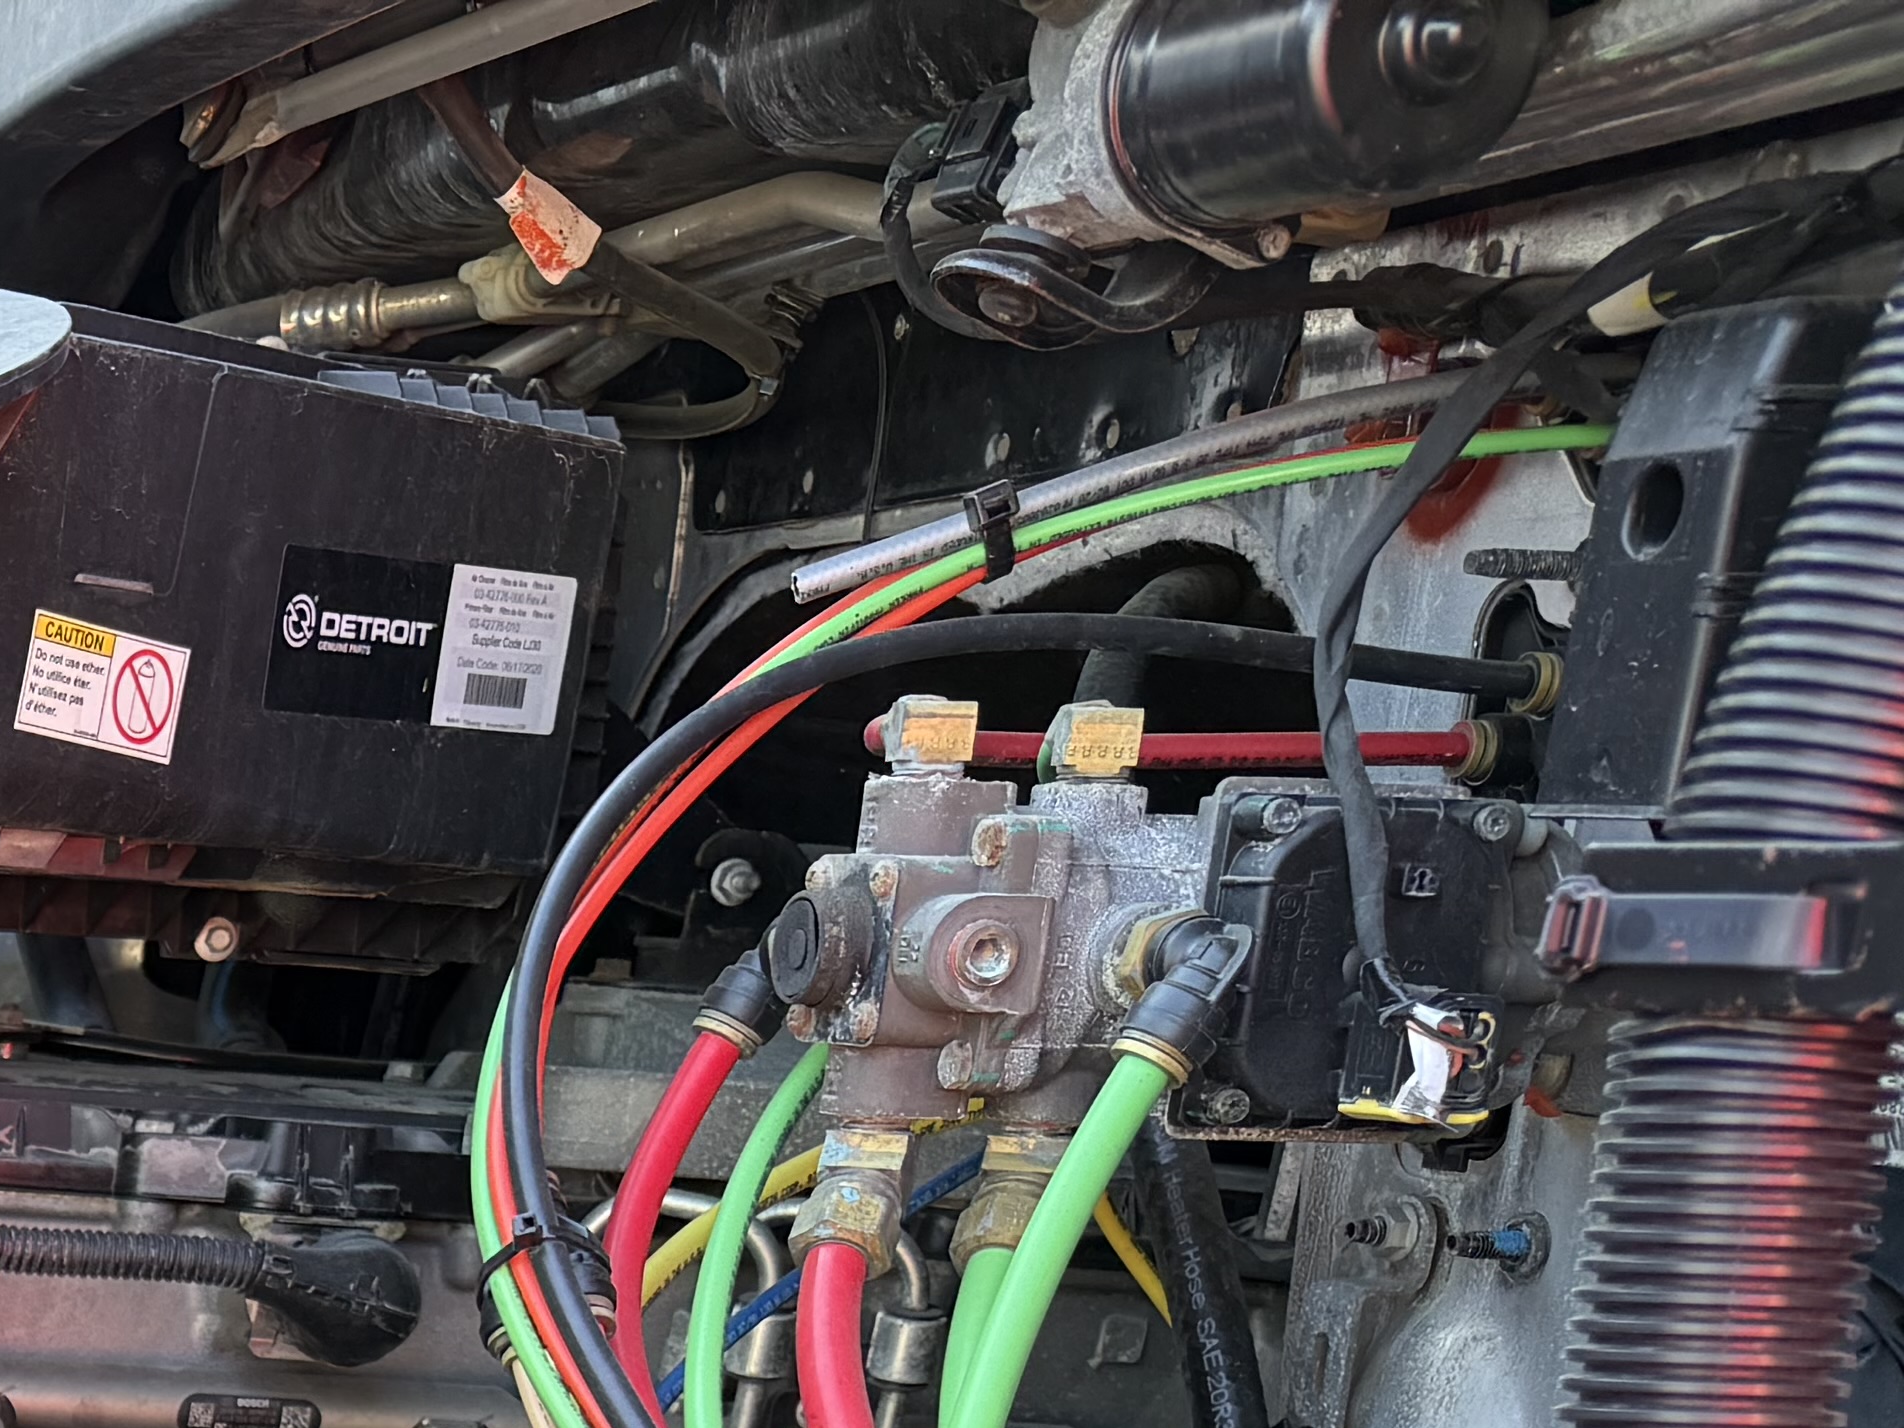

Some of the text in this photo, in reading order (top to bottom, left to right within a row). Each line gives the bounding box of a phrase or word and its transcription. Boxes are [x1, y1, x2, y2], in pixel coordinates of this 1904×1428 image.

[46, 621, 105, 652] CAUTION
[319, 611, 433, 647] DETROIT
[472, 633, 522, 649] Supplier Code
[35, 648, 47, 660] Do
[49, 652, 63, 664] not
[457, 656, 498, 669] Date Code:
[69, 695, 84, 706] pas
[1165, 1167, 1191, 1246] Heater
[1180, 1245, 1204, 1308] Hose
[1197, 1317, 1225, 1373] SAE
